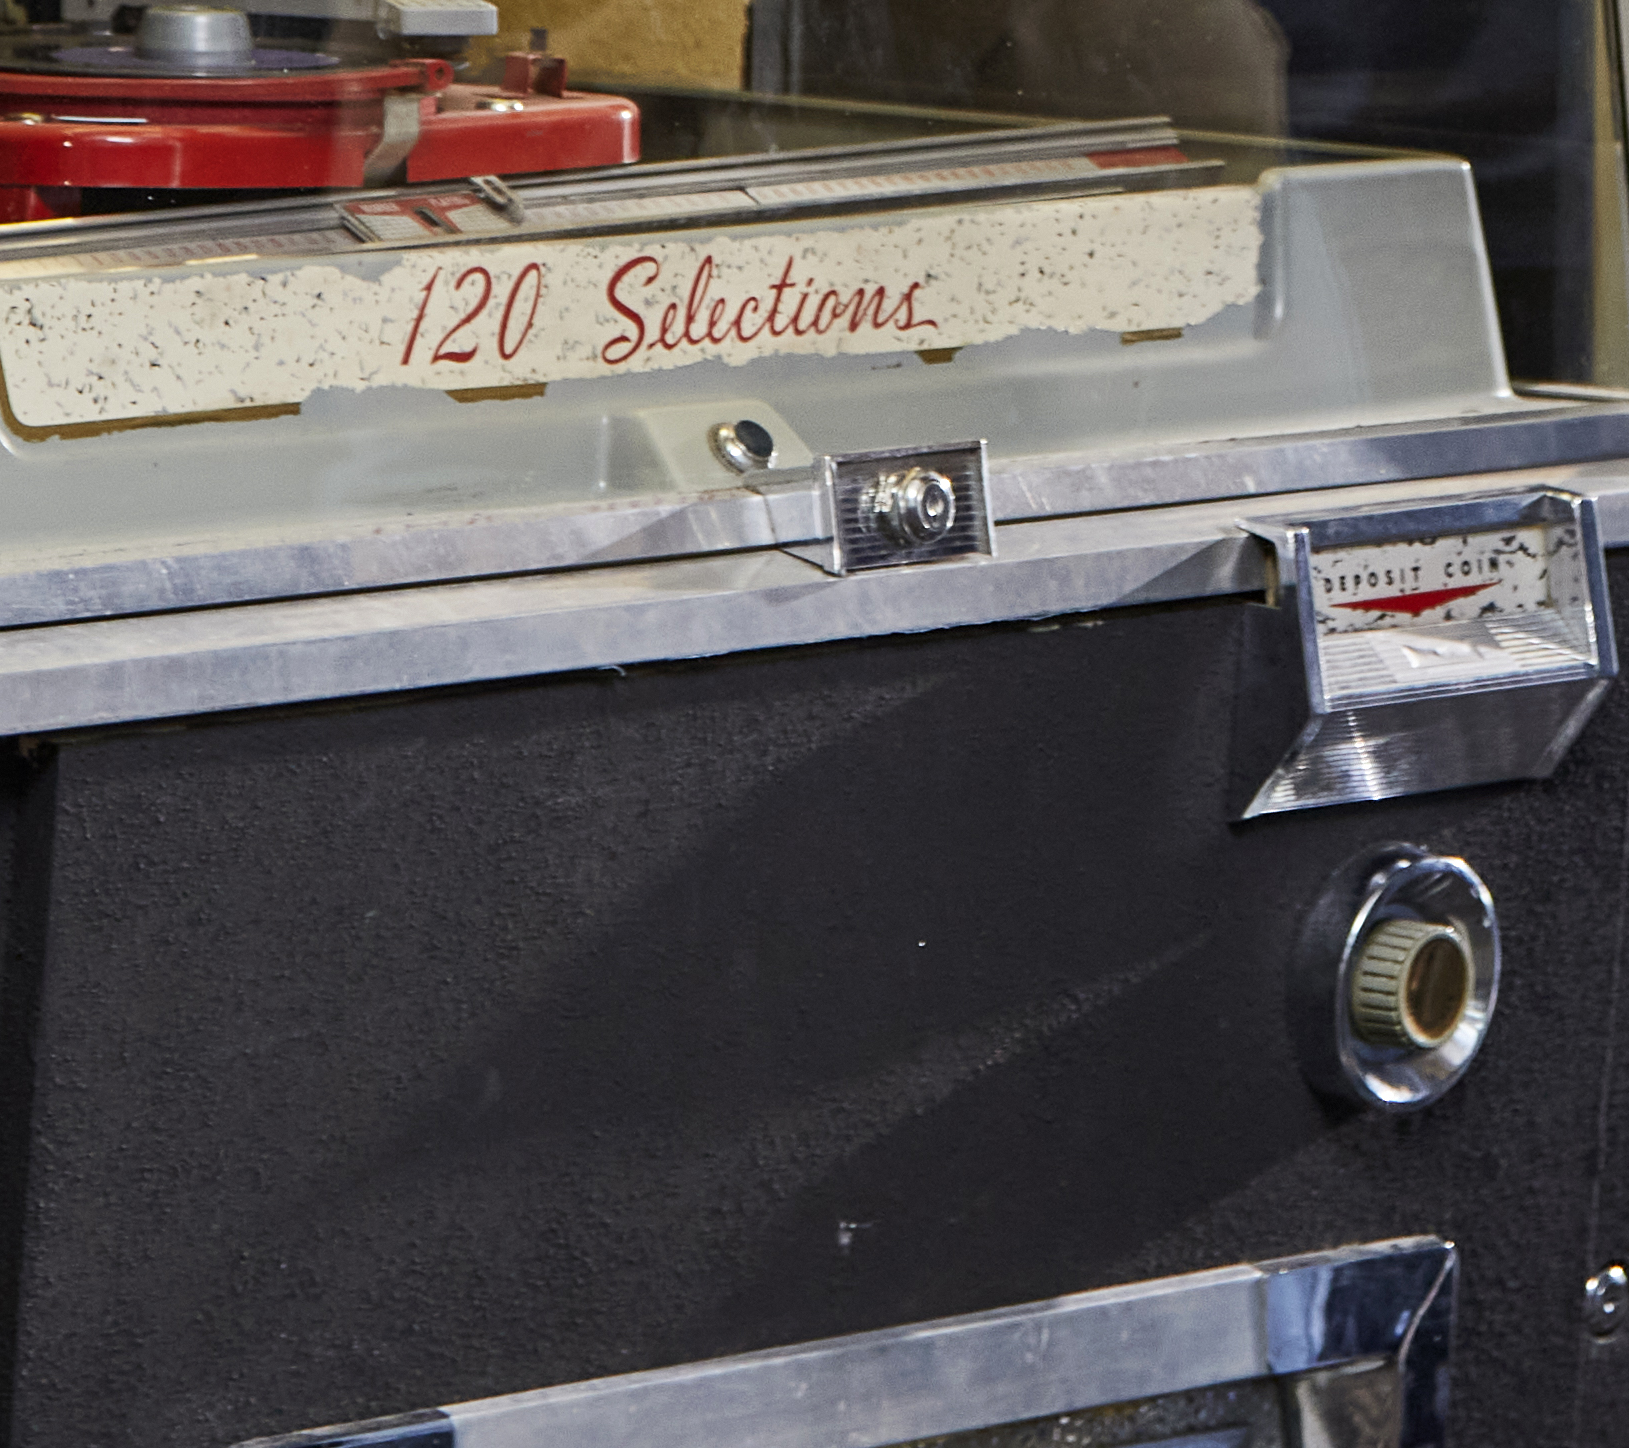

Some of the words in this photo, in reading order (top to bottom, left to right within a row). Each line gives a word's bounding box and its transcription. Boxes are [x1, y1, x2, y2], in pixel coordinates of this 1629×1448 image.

[402, 263, 545, 368] 120
[601, 254, 939, 368] Selections
[1323, 566, 1420, 593] DEPOSIT
[1444, 557, 1499, 578] COIN
